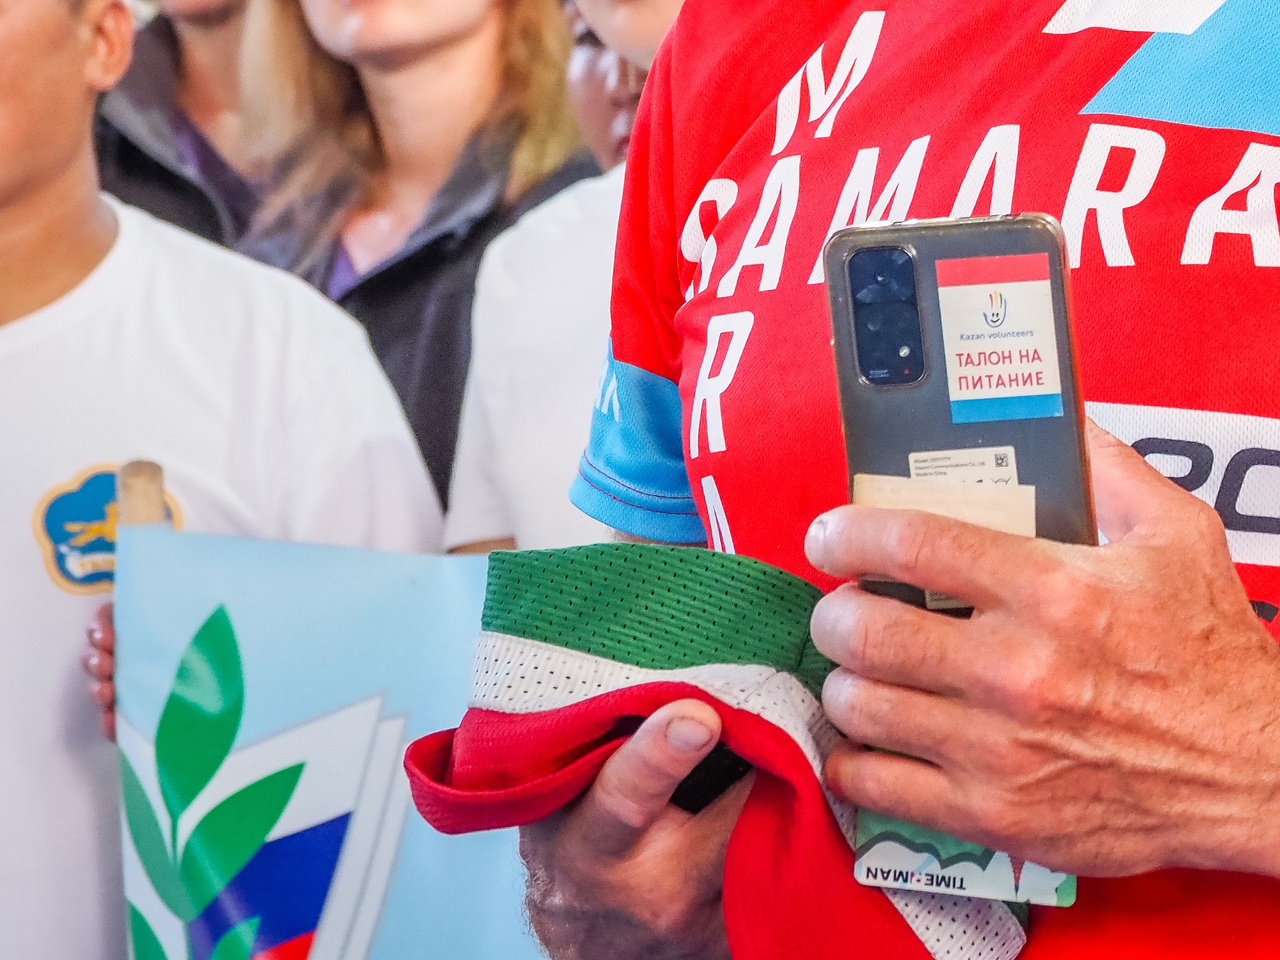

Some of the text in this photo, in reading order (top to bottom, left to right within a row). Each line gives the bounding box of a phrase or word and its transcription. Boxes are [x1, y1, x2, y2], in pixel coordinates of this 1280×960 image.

[960, 330, 1034, 340] Kazan volunteers
[955, 348, 1042, 367] ТАЛОН НА
[958, 371, 1044, 391] ПИТАНИЕ
